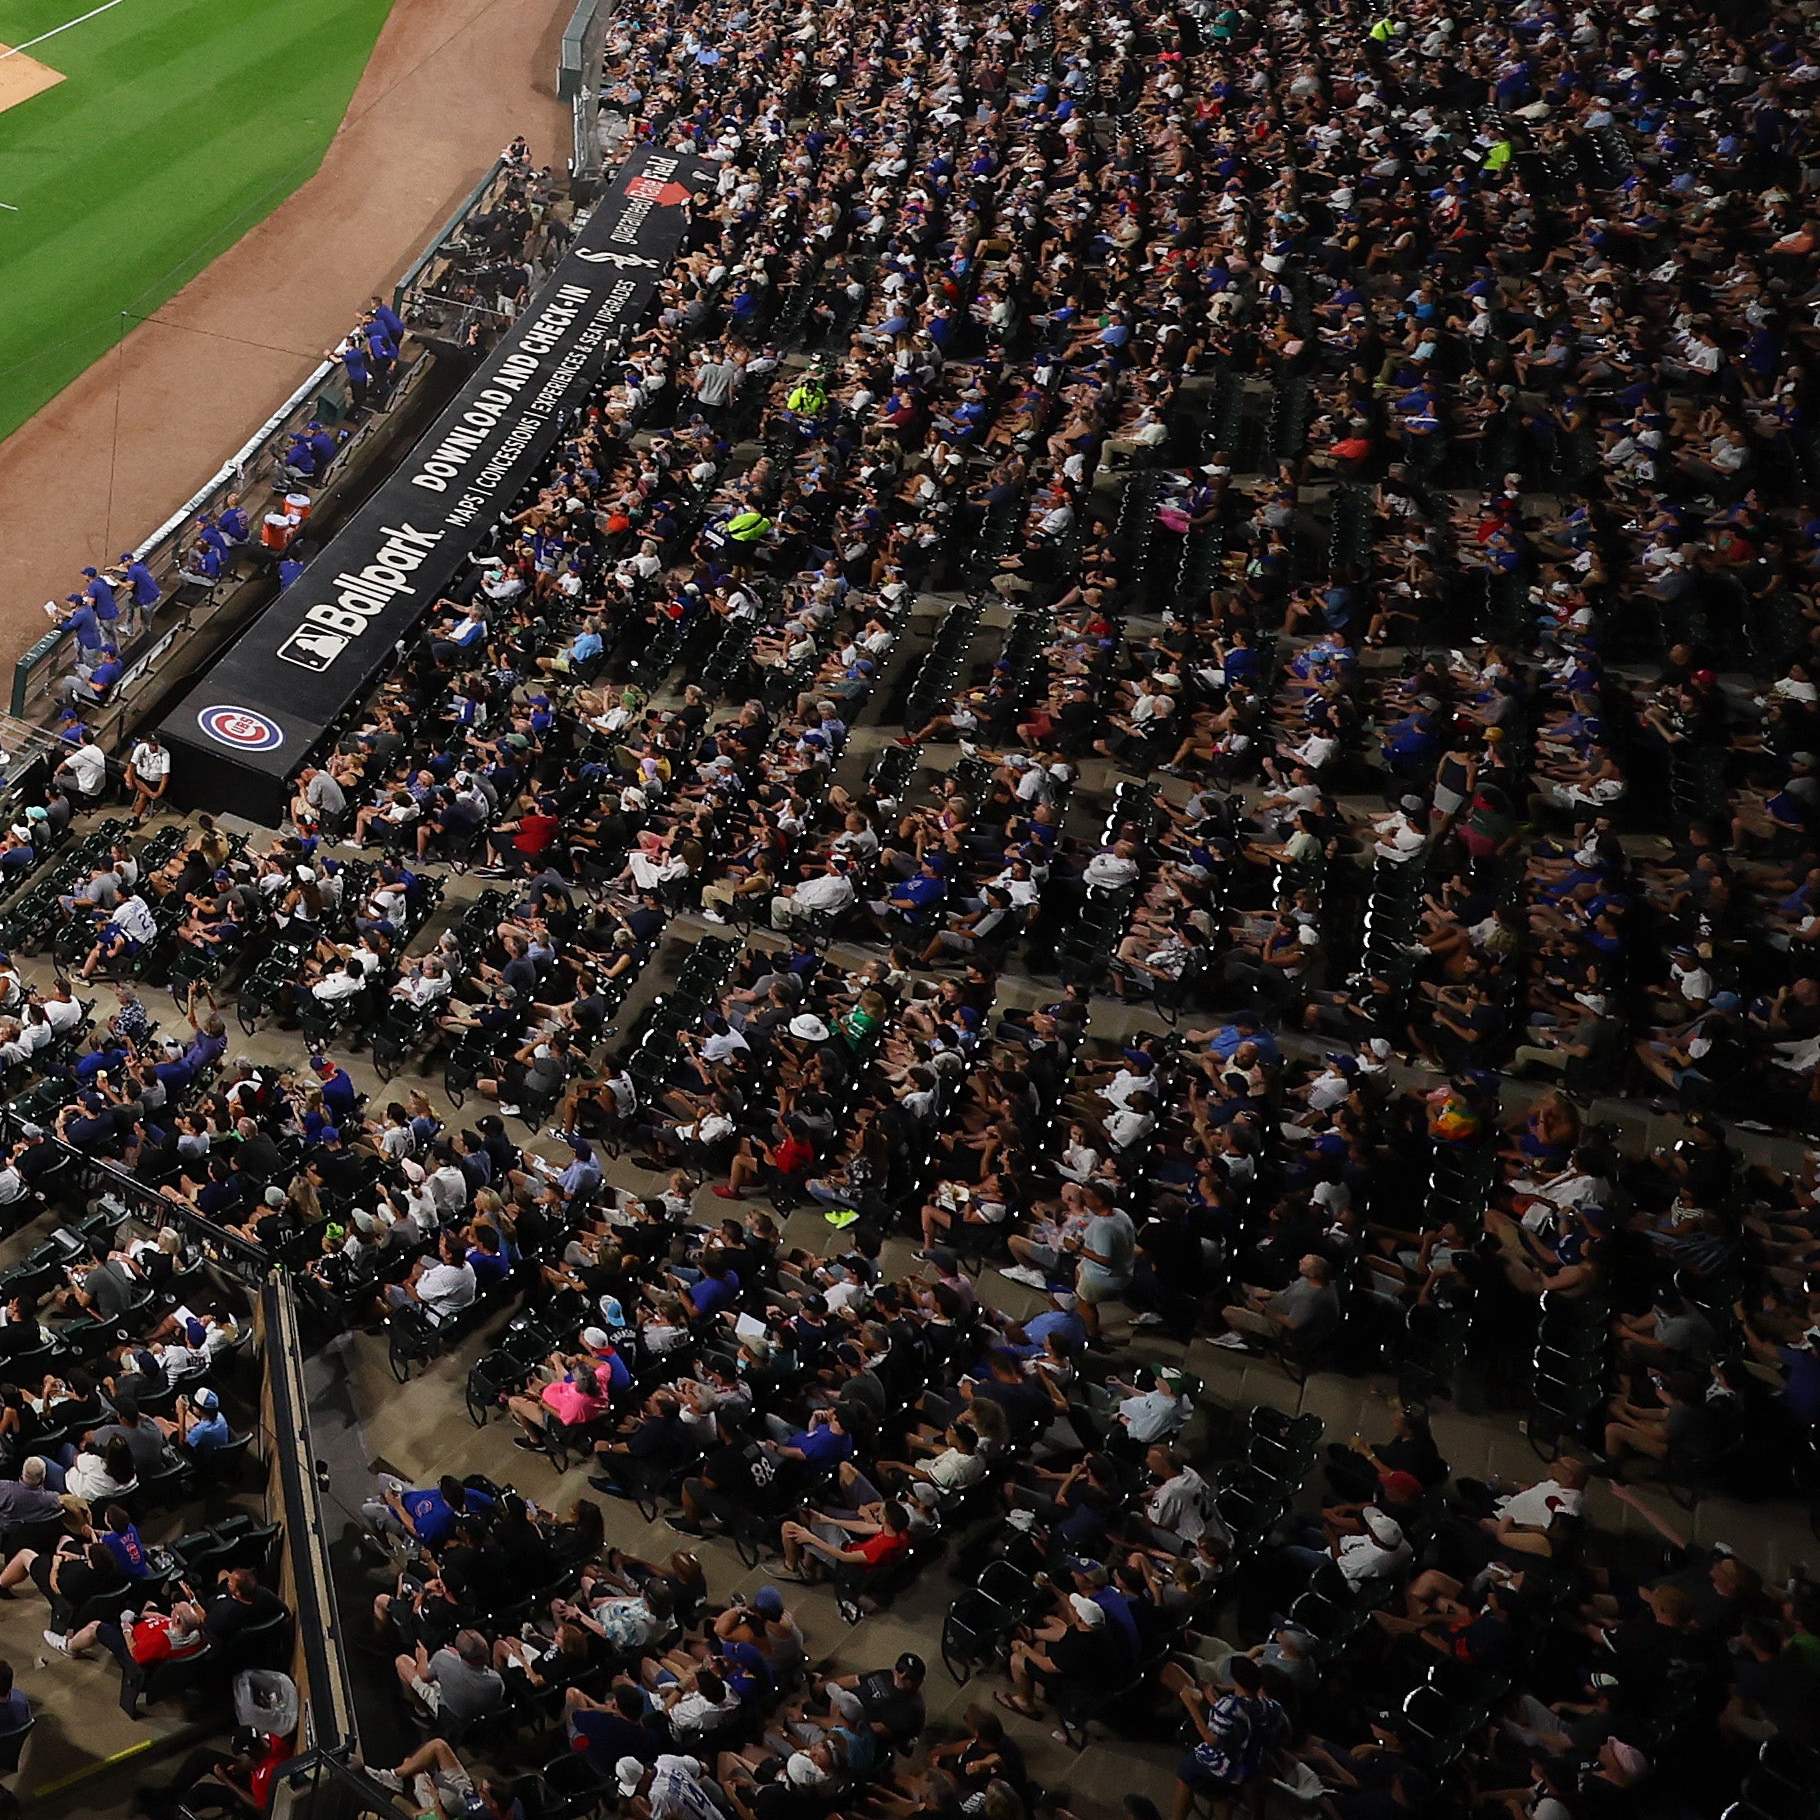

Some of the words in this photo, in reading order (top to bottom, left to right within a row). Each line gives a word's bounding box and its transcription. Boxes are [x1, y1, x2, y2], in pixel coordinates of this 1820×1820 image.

[631, 176, 665, 202] Rate
[645, 154, 680, 183] Field
[610, 197, 654, 246] guaranteed
[593, 278, 637, 327] UPGRADES
[577, 336, 593, 354] &
[581, 317, 610, 347] SEAT
[411, 393, 515, 492] DOWNLOAD
[492, 353, 542, 407] AND
[521, 283, 592, 364] CHECK-IN
[531, 350, 588, 414] EXPERIENCES
[473, 417, 540, 488] CONCESSIONS
[444, 489, 481, 528] MAPS
